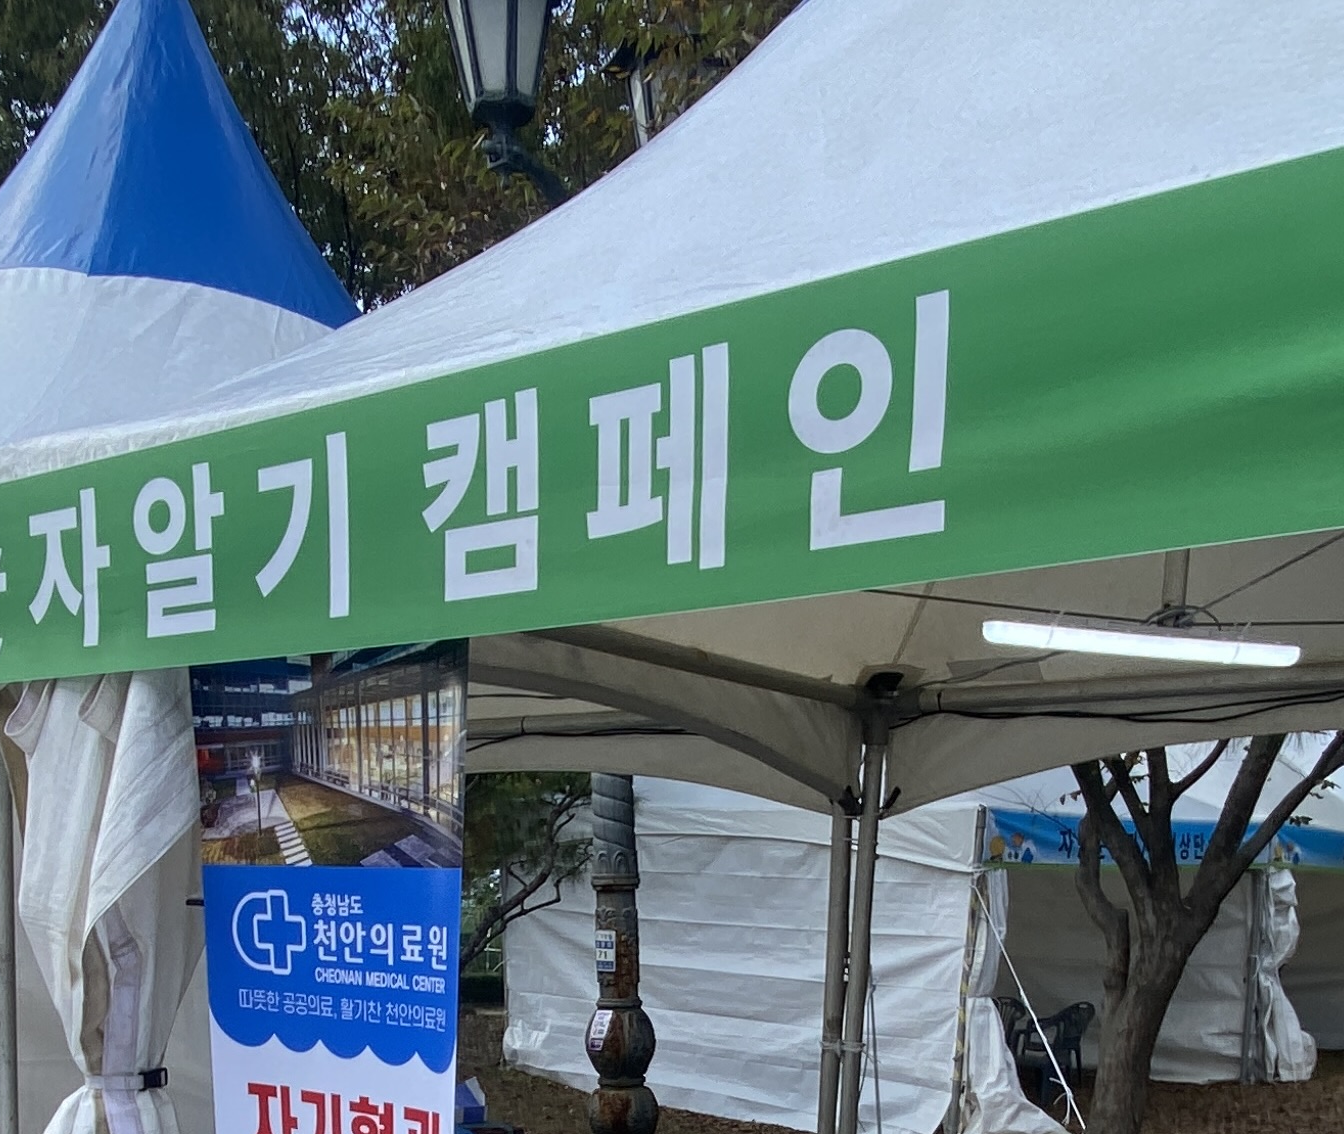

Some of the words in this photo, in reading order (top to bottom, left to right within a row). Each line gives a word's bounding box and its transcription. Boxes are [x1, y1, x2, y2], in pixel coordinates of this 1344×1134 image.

[421, 289, 951, 602] 캠페인
[311, 892, 364, 917] 충청남도
[313, 919, 448, 971] 천안의료원
[314, 967, 362, 985] CHEONAN
[365, 971, 410, 990] MEDICAL
[412, 975, 446, 994] CENTER
[238, 988, 280, 1012] 따뜻한
[282, 992, 337, 1020] 공공의료,
[340, 997, 382, 1024] 활기찬
[385, 1002, 446, 1033] 천안의료원
